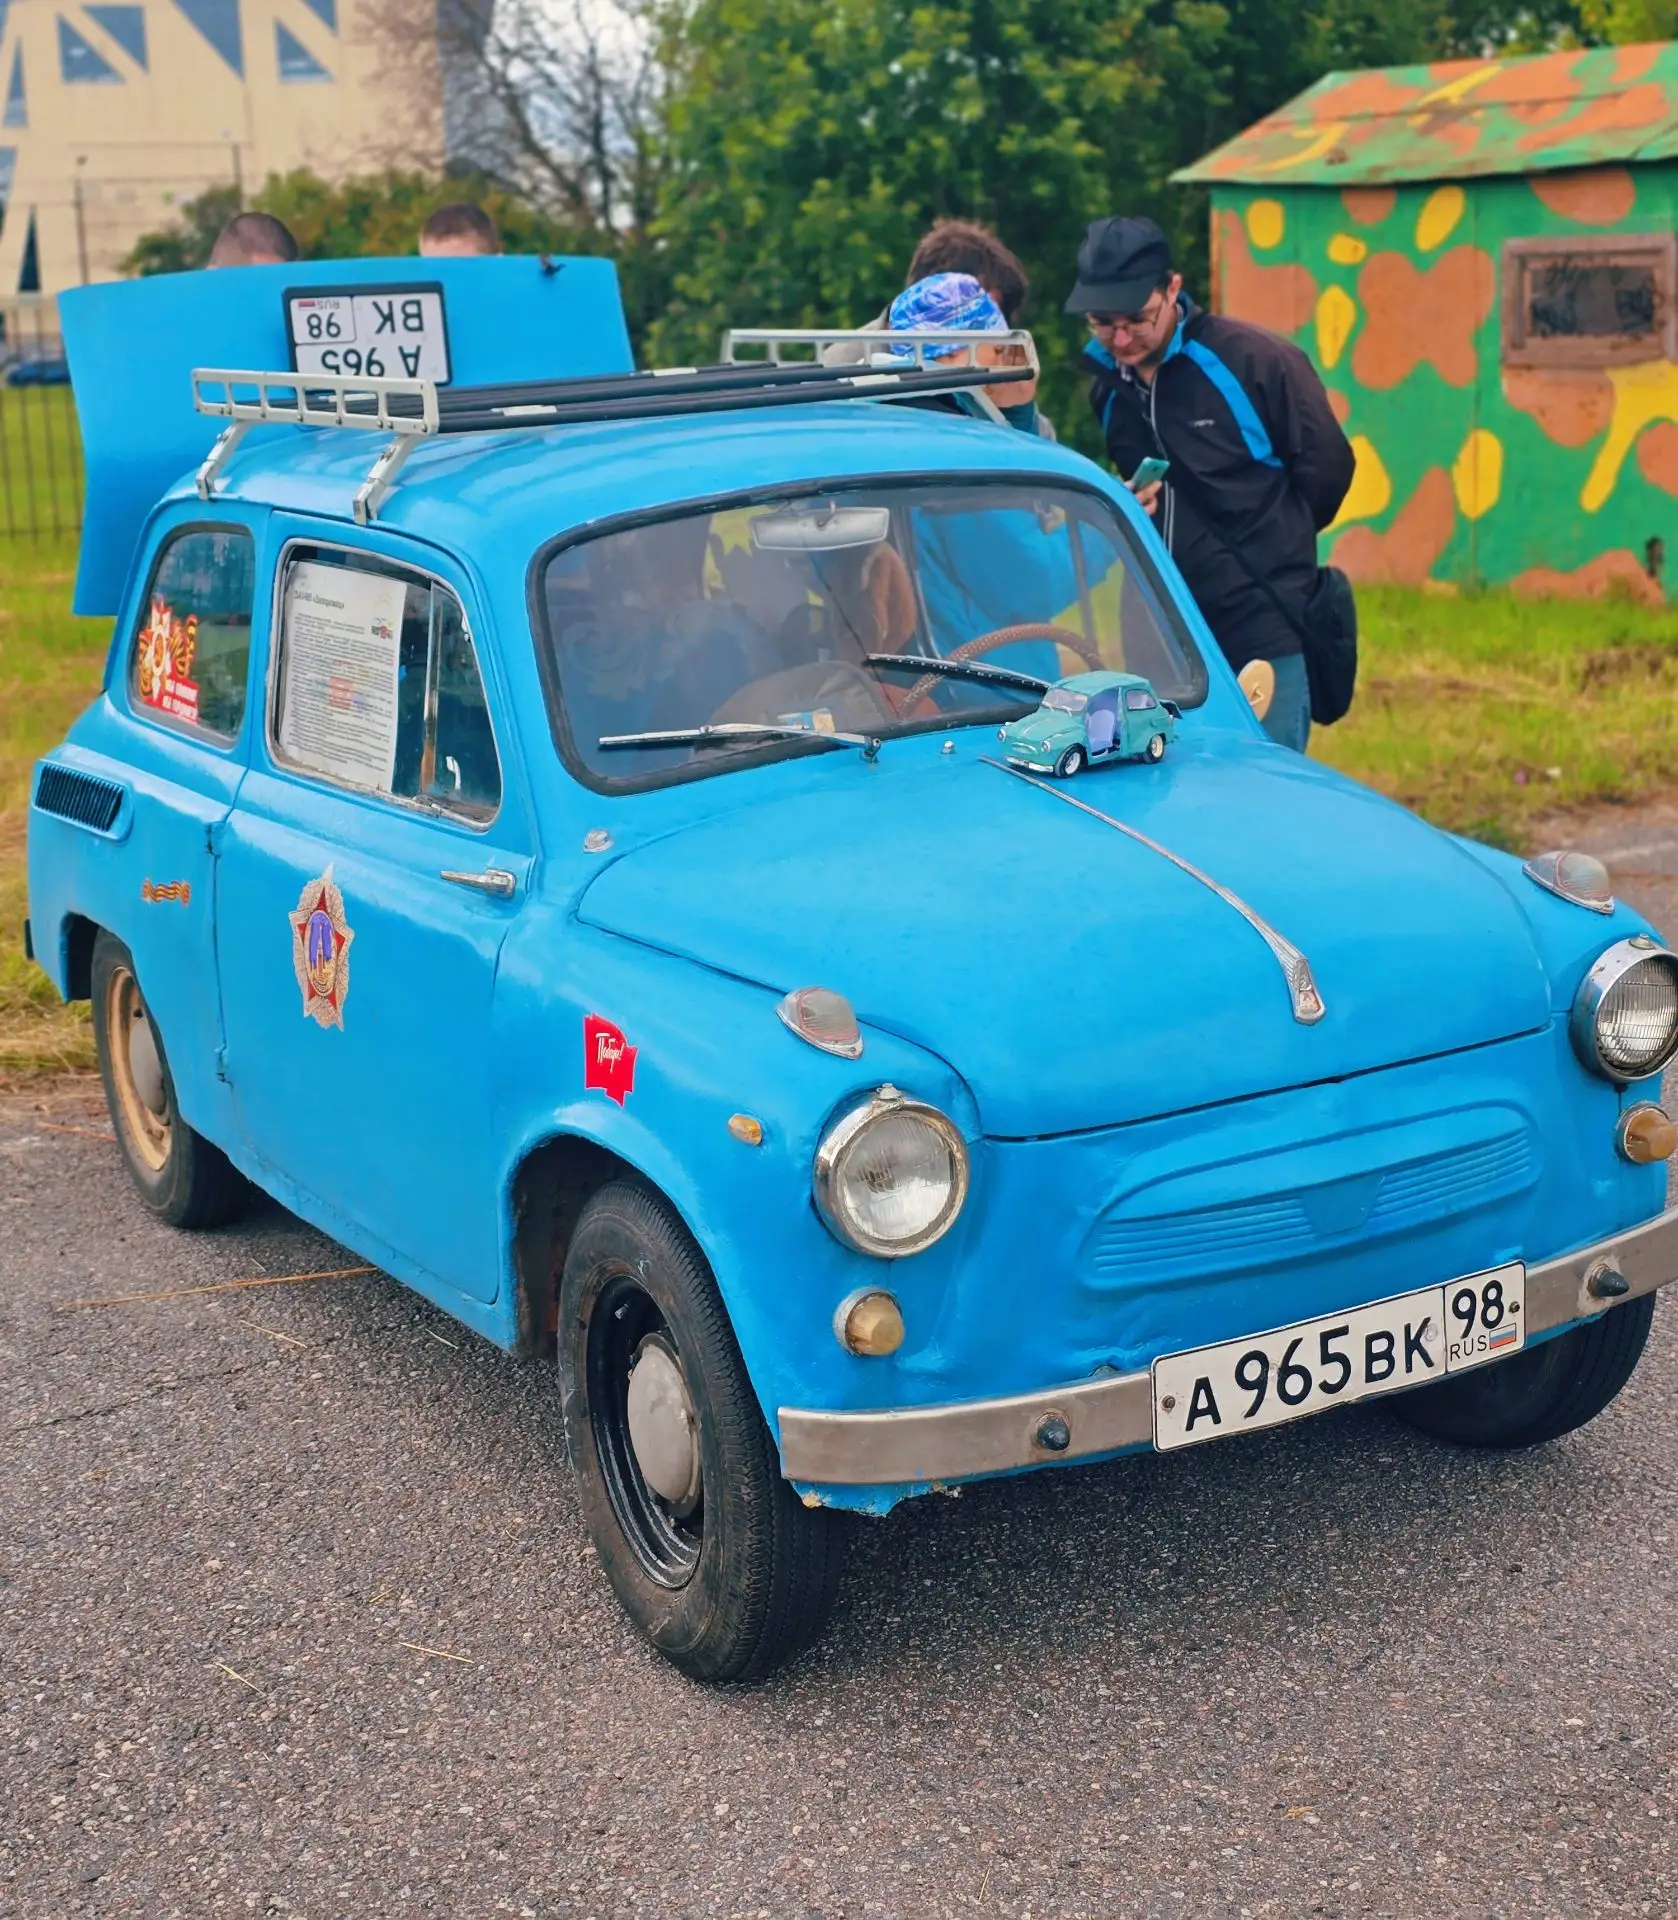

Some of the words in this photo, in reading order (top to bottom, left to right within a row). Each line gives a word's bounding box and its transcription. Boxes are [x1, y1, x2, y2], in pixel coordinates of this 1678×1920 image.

[317, 300, 340, 310] RUS
[307, 312, 341, 339] 98
[320, 347, 385, 377] 965
[1452, 1279, 1504, 1339] 98
[1449, 1334, 1488, 1362] RUS
